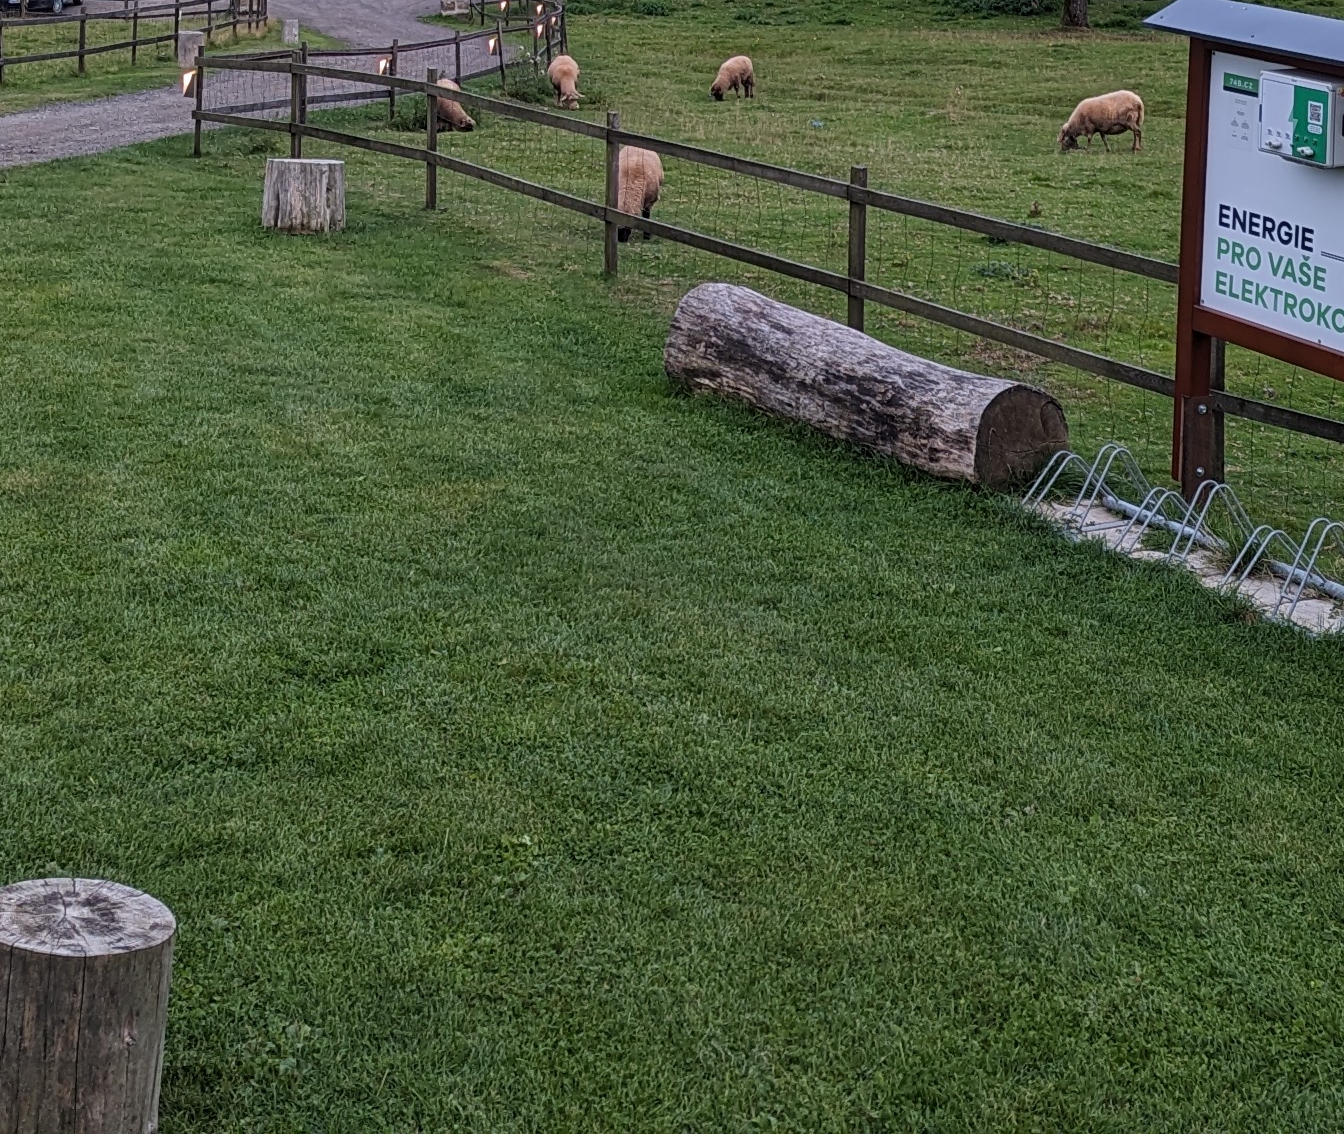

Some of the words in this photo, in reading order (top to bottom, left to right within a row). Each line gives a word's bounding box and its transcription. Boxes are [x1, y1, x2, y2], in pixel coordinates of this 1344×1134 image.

[1218, 203, 1315, 253] ENERGIE
[1217, 237, 1262, 271] PRO
[1267, 251, 1327, 293] VAŠE
